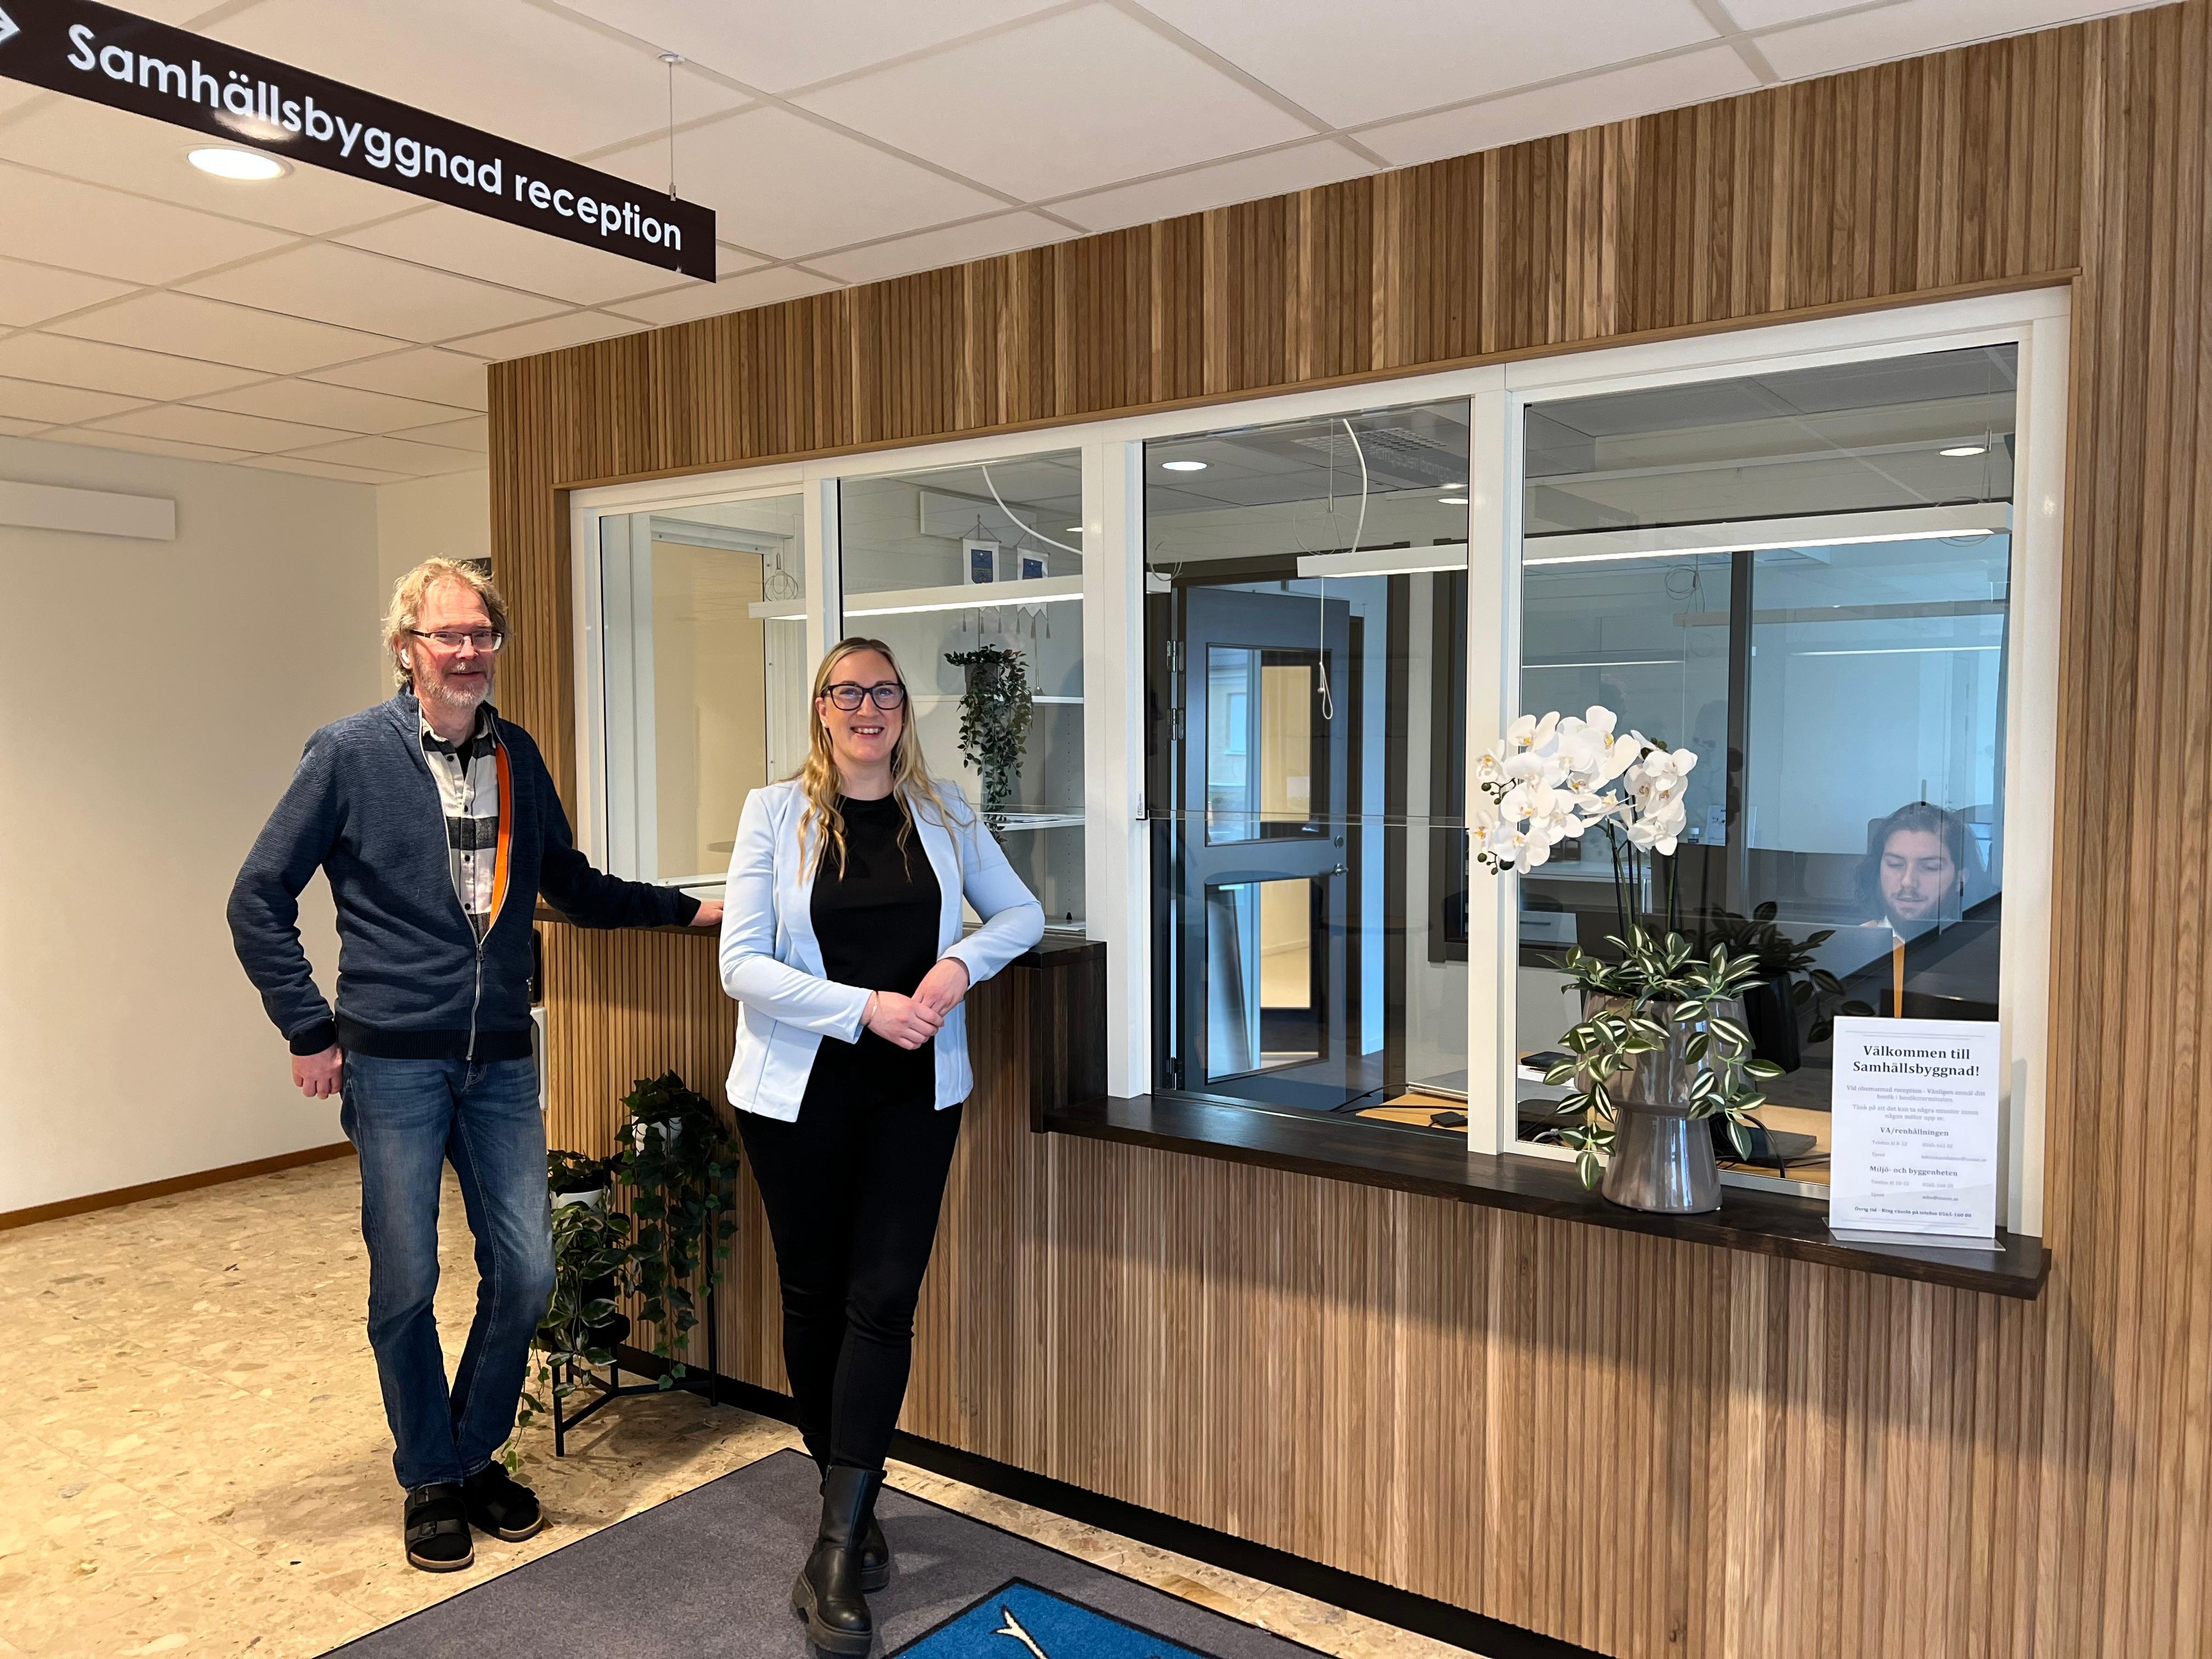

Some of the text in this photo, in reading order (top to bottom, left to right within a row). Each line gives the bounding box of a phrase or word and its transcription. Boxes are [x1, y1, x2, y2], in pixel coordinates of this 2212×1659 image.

[67, 24, 681, 250] Samhällsbyggnad reception
[1864, 1045, 1970, 1059] Välkommen till
[1853, 1061, 1979, 1077] Samhällsbyggnad!
[1880, 1127, 1949, 1137] VA/renhållningen
[1909, 1167, 1957, 1176] byggenheten
